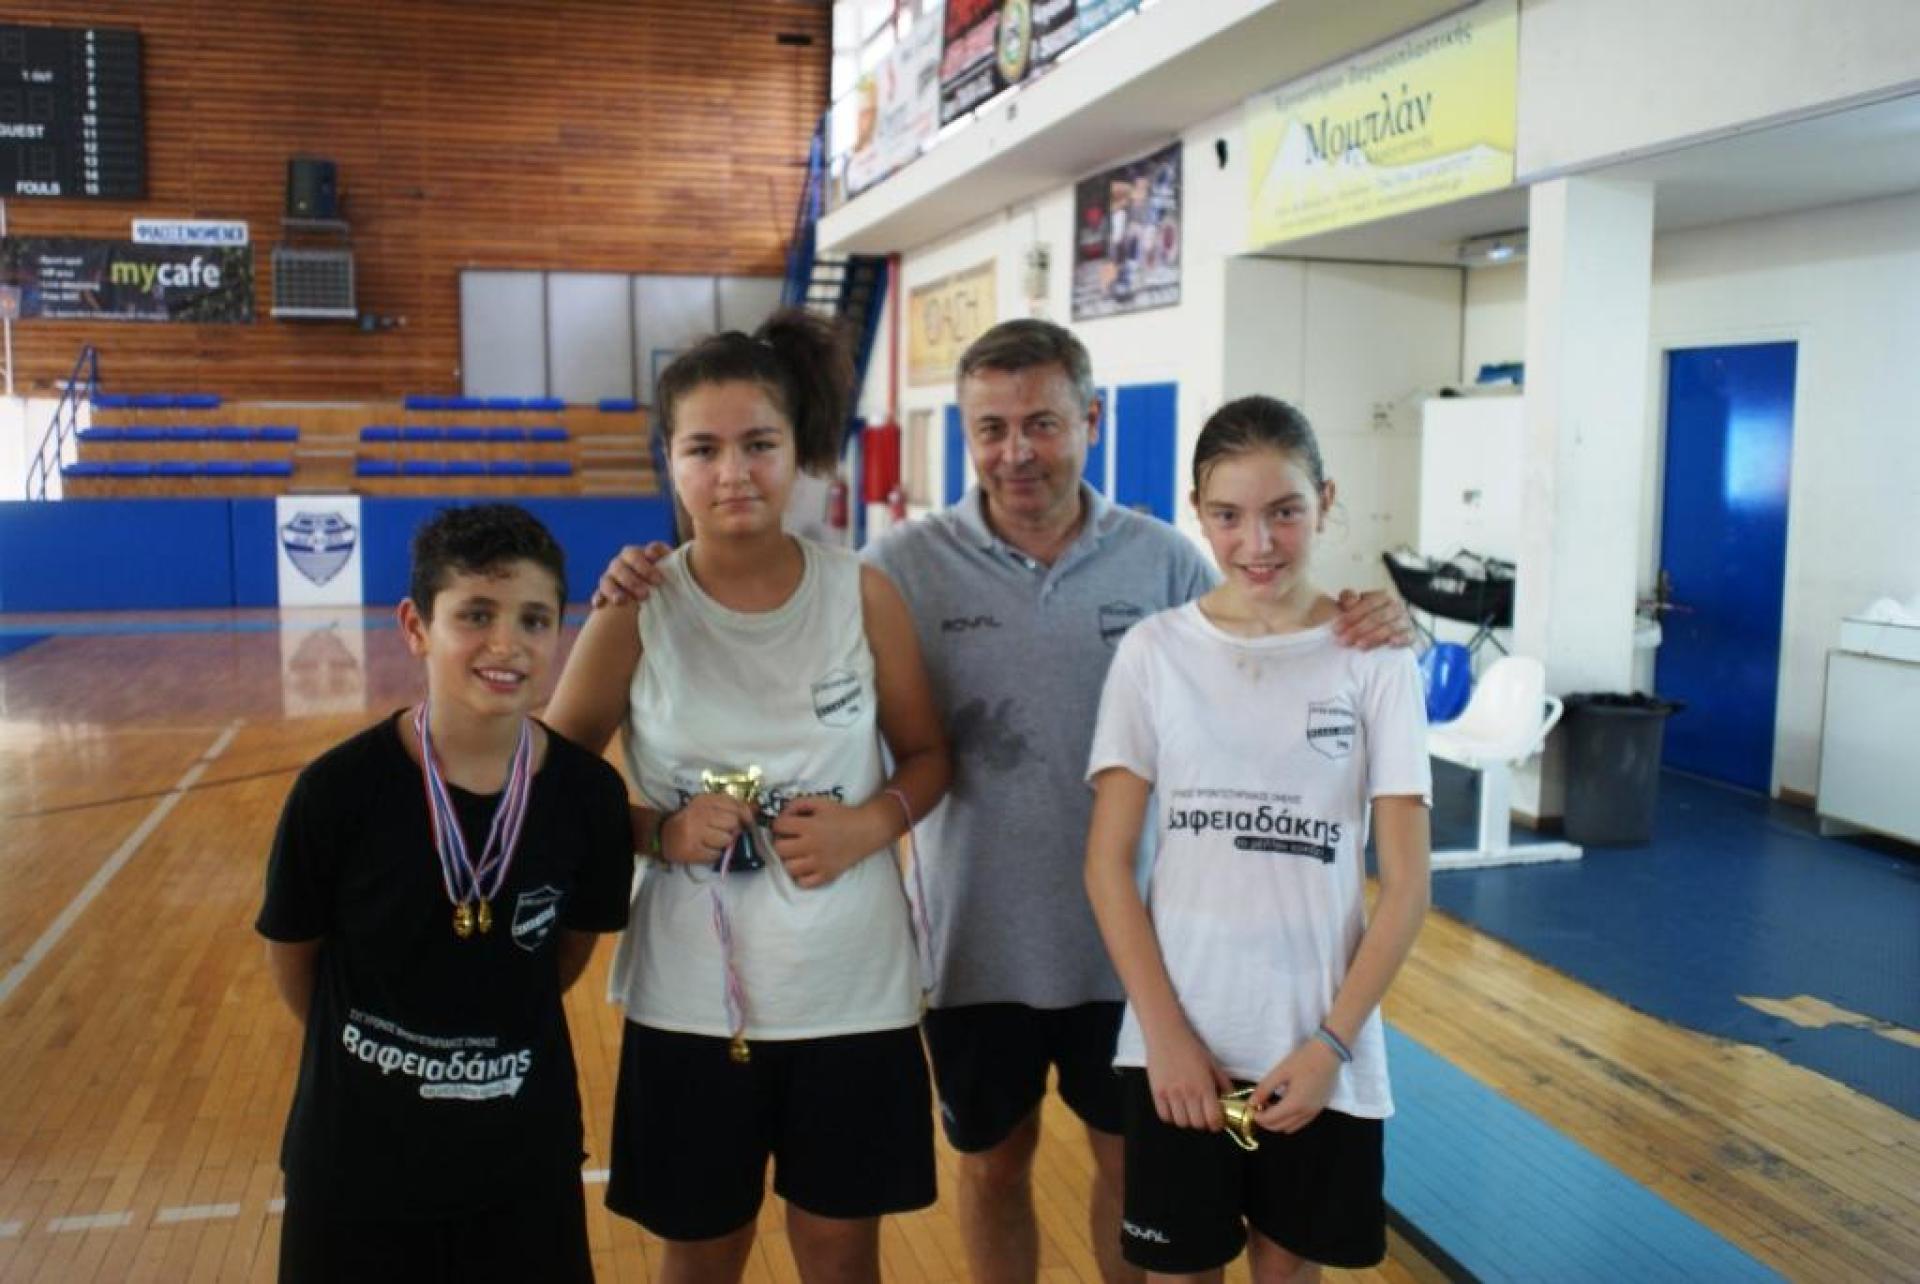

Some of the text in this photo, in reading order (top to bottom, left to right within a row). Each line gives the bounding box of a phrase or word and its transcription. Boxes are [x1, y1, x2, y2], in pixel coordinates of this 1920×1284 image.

[1305, 84, 1433, 165] Μομπλάν
[16, 181, 60, 195] FOULS
[111, 257, 221, 294] mycafe
[343, 1024, 532, 1081] Βαφειαδάκης
